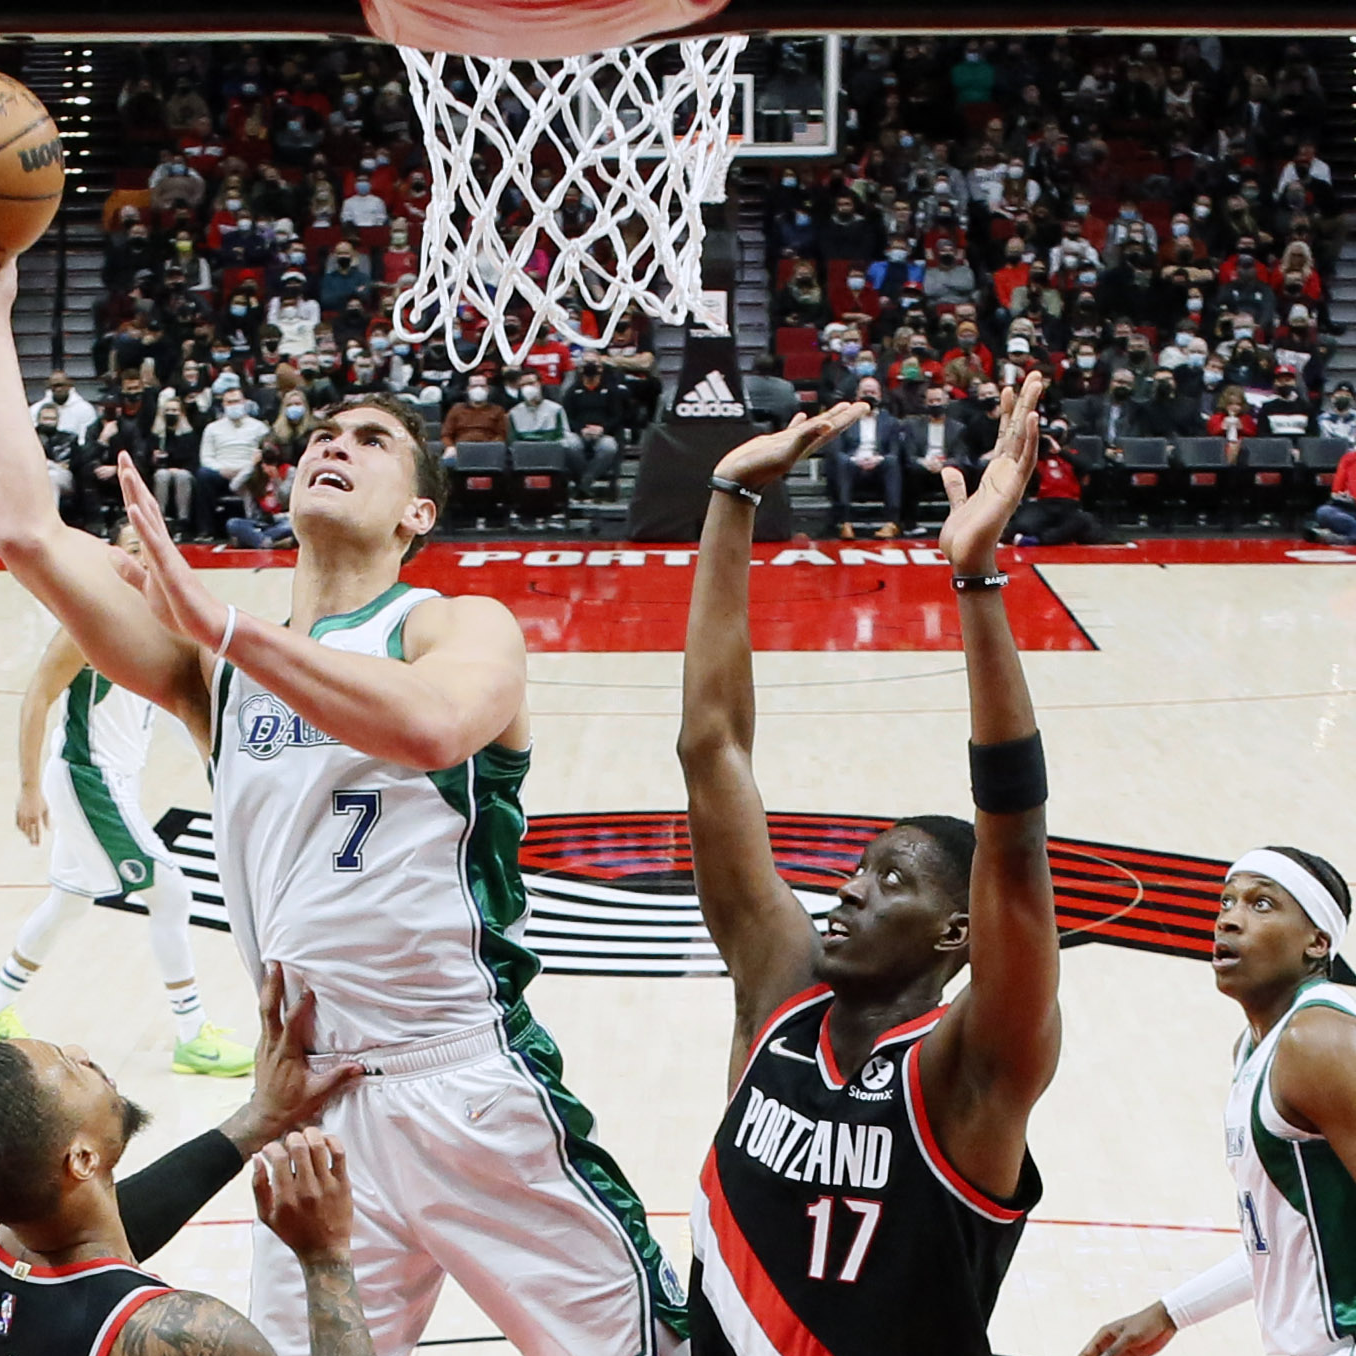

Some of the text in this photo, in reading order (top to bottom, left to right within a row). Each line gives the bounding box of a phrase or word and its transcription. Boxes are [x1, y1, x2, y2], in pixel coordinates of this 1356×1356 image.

[676, 402, 744, 417] adidas
[458, 549, 950, 567] PORTAND
[333, 790, 381, 872] 7
[848, 1084, 894, 1101] StormX
[734, 1086, 893, 1189] PORTLAND
[806, 1195, 884, 1283] 17
